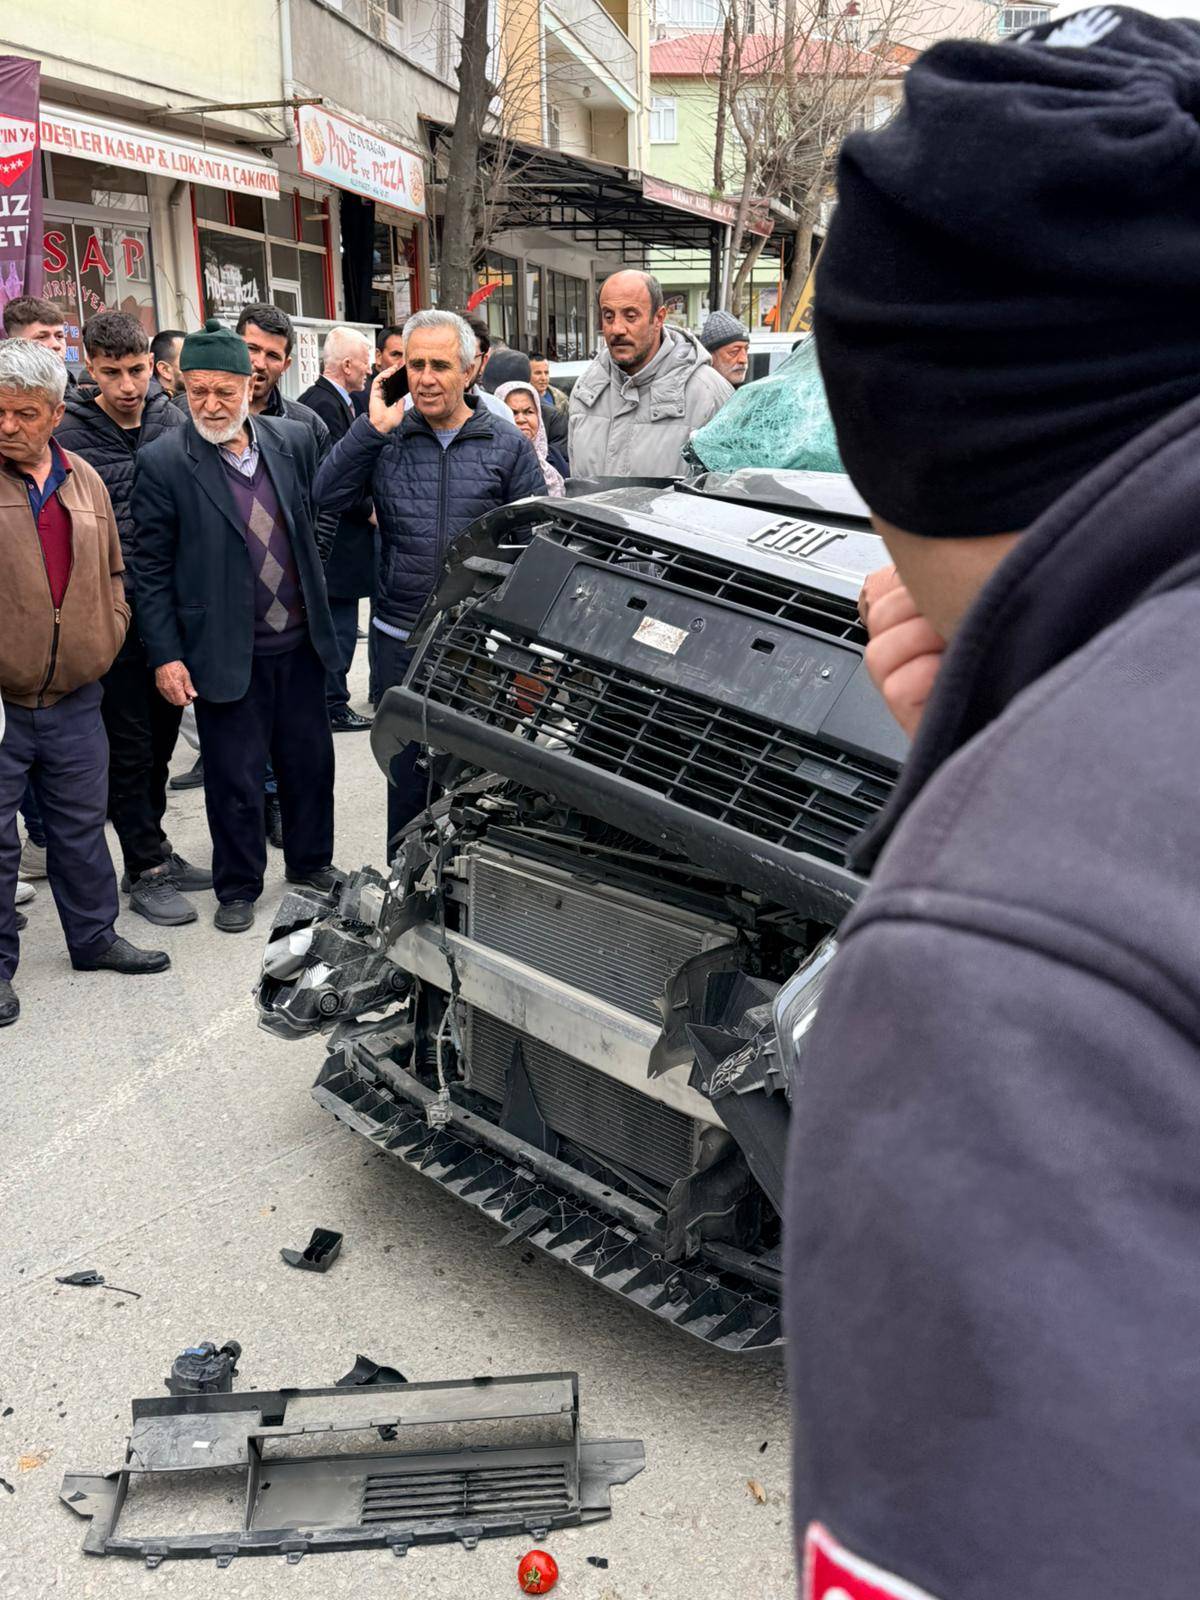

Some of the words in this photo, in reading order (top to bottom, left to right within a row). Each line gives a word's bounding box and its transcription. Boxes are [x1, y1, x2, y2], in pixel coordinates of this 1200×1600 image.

[105, 135, 155, 165] KASAP
[158, 146, 169, 169] &
[171, 151, 231, 183] LOKANTA
[42, 230, 145, 278] SAP
[746, 520, 848, 558] FIAT
